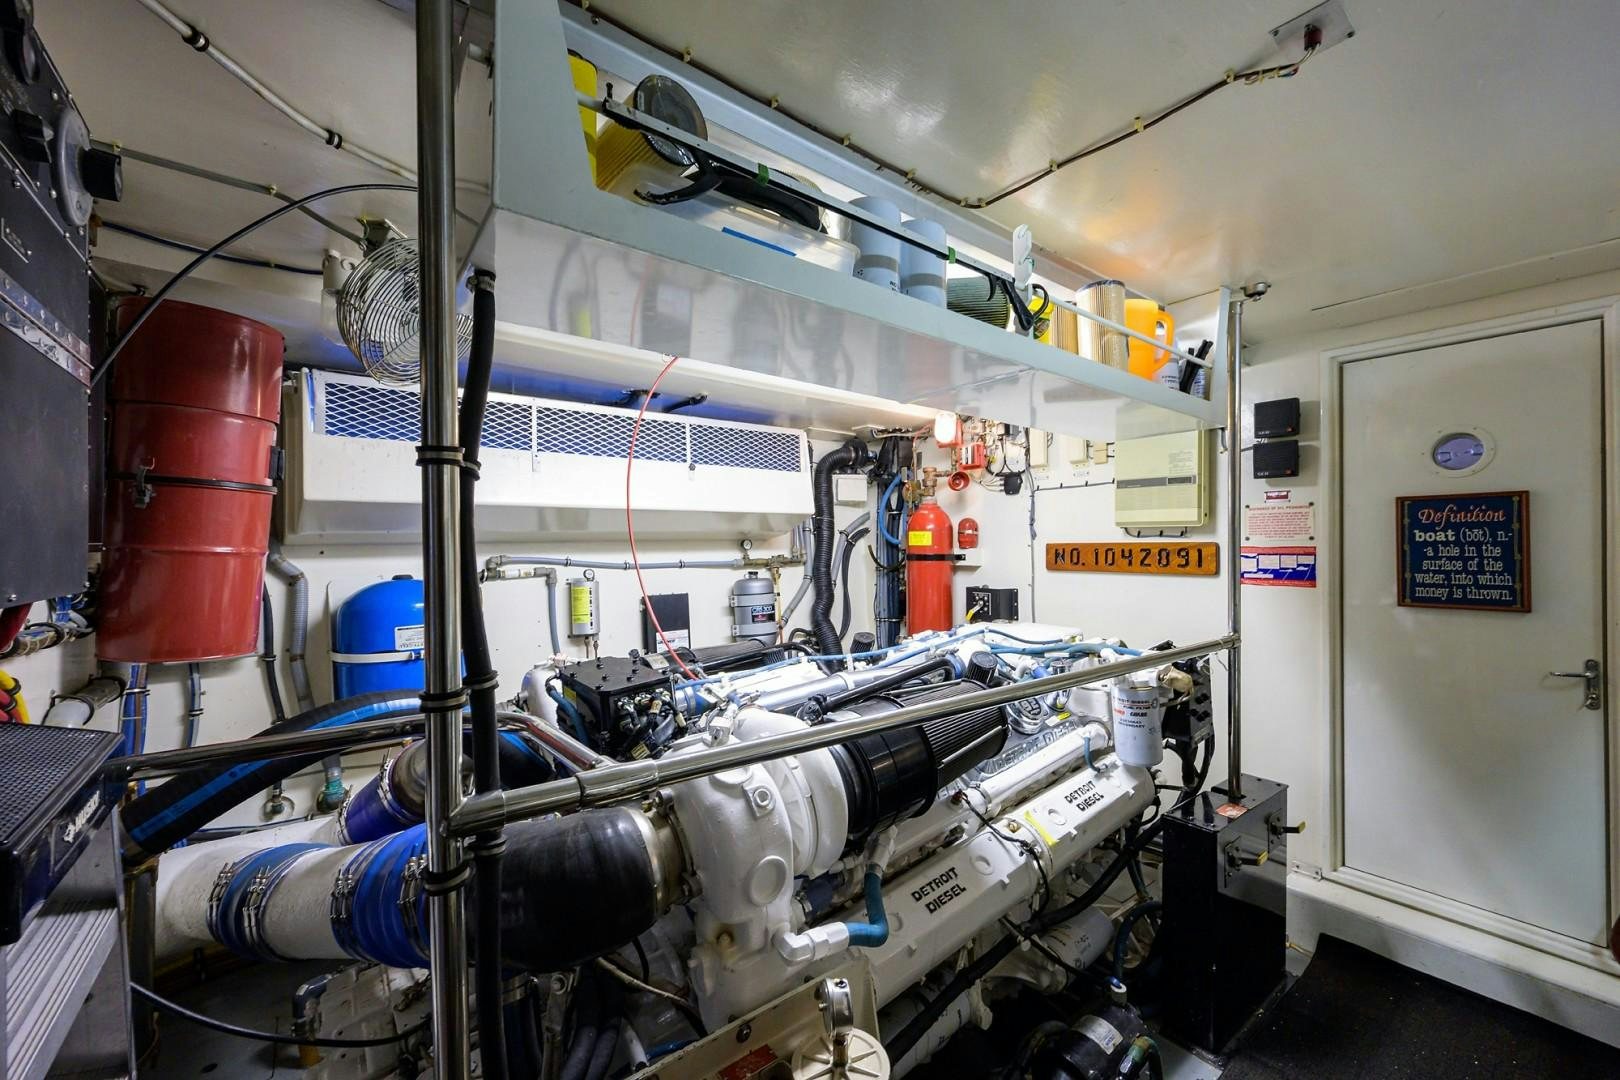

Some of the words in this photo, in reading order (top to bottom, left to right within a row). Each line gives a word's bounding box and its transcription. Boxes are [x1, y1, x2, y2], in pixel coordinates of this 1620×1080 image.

[1418, 504, 1506, 530] Definition
[1414, 529, 1456, 542] boat
[1438, 544, 1460, 557] hole
[1464, 544, 1477, 557] in
[1482, 544, 1501, 557] the
[1422, 558, 1463, 570] surface
[1467, 558, 1479, 570] of
[1483, 559, 1503, 571] the
[1451, 573, 1474, 584] into
[1477, 573, 1512, 586] which
[1415, 586, 1449, 600] money
[1453, 586, 1463, 598] is
[1064, 780, 1096, 804] DETROIT
[1076, 792, 1104, 812] DIESEL
[911, 866, 958, 902] DETROIT
[925, 883, 967, 914] DIESEL
